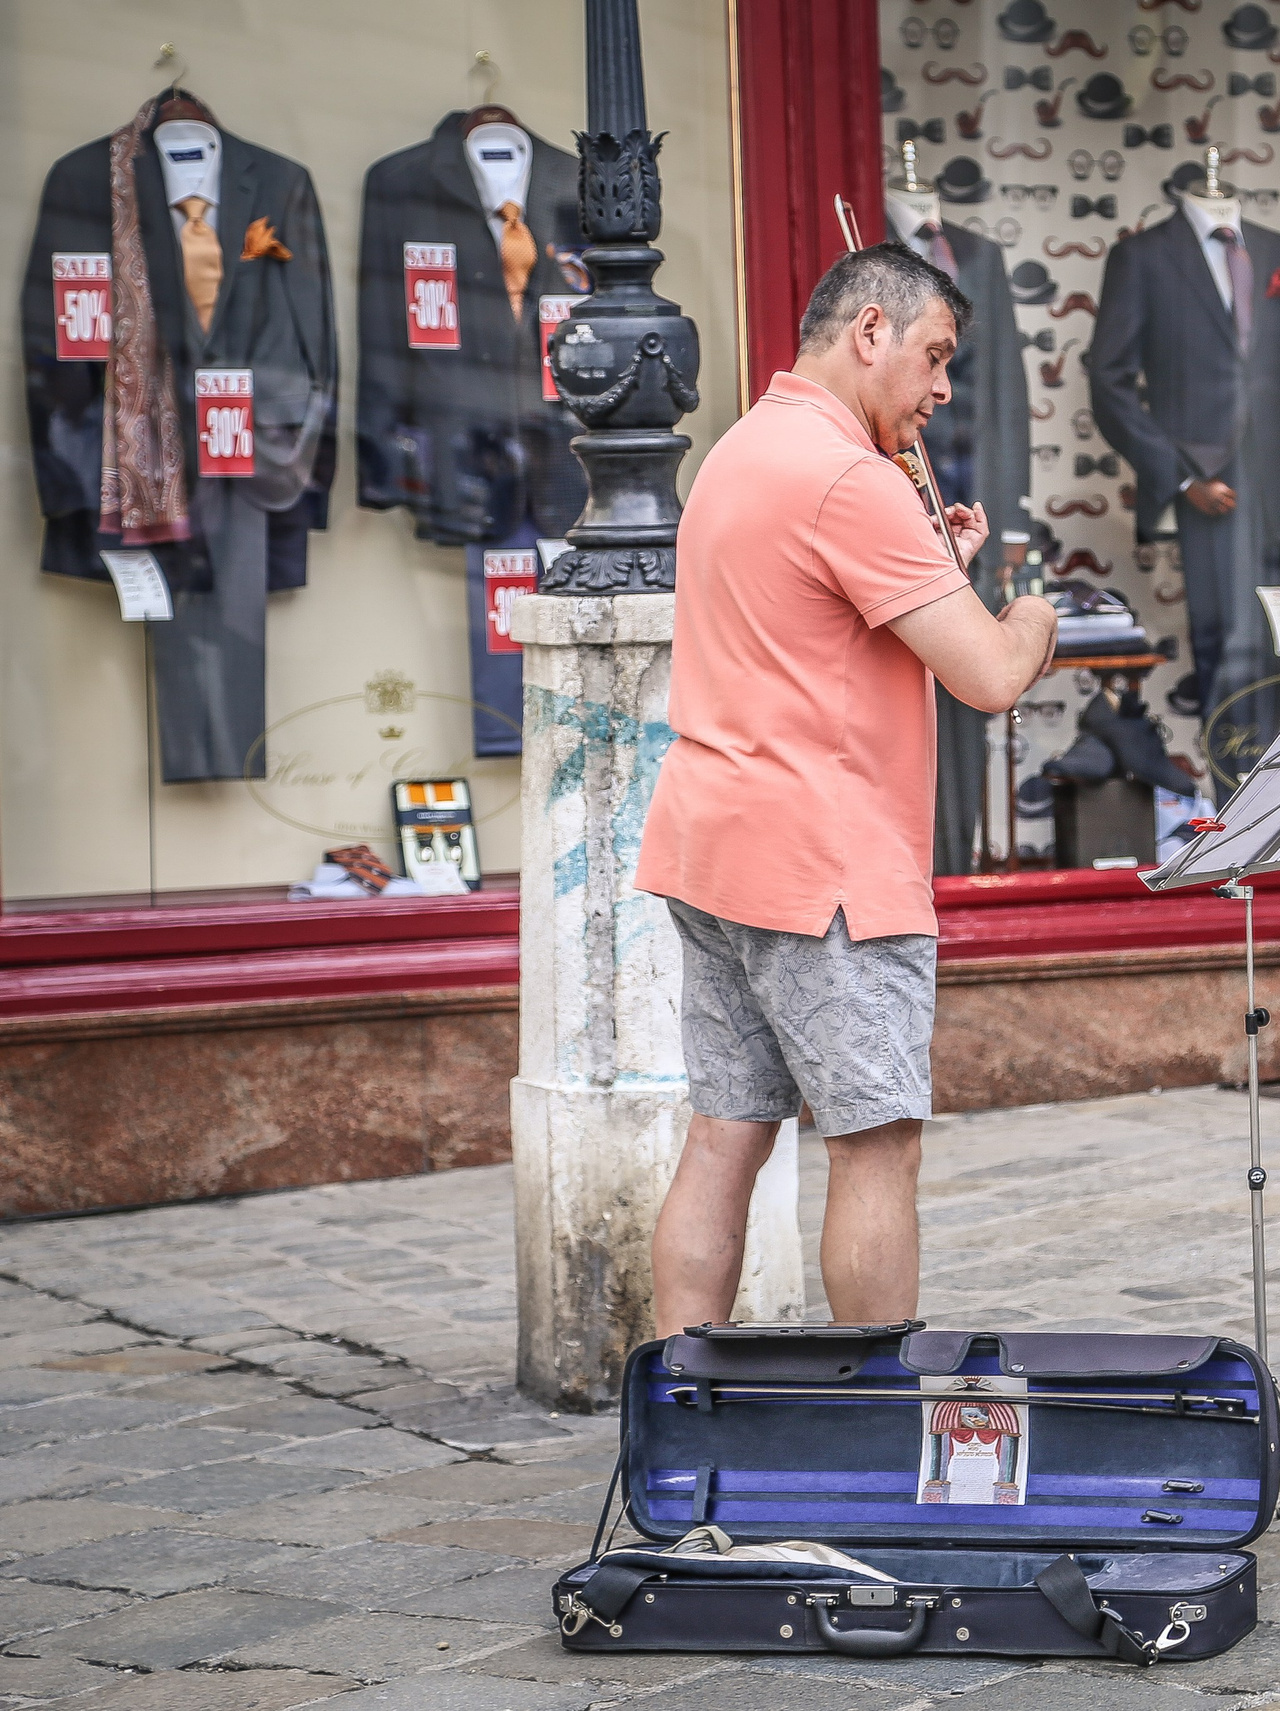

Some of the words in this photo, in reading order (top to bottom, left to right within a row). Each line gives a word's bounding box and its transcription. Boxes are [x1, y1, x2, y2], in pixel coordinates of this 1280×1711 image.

[404, 247, 455, 267] SALE
[53, 258, 108, 277] SALE
[408, 279, 457, 330] -30%
[58, 289, 112, 342] -50%
[196, 375, 250, 394] SALE
[199, 407, 254, 458] -30%
[485, 555, 536, 574] SALE
